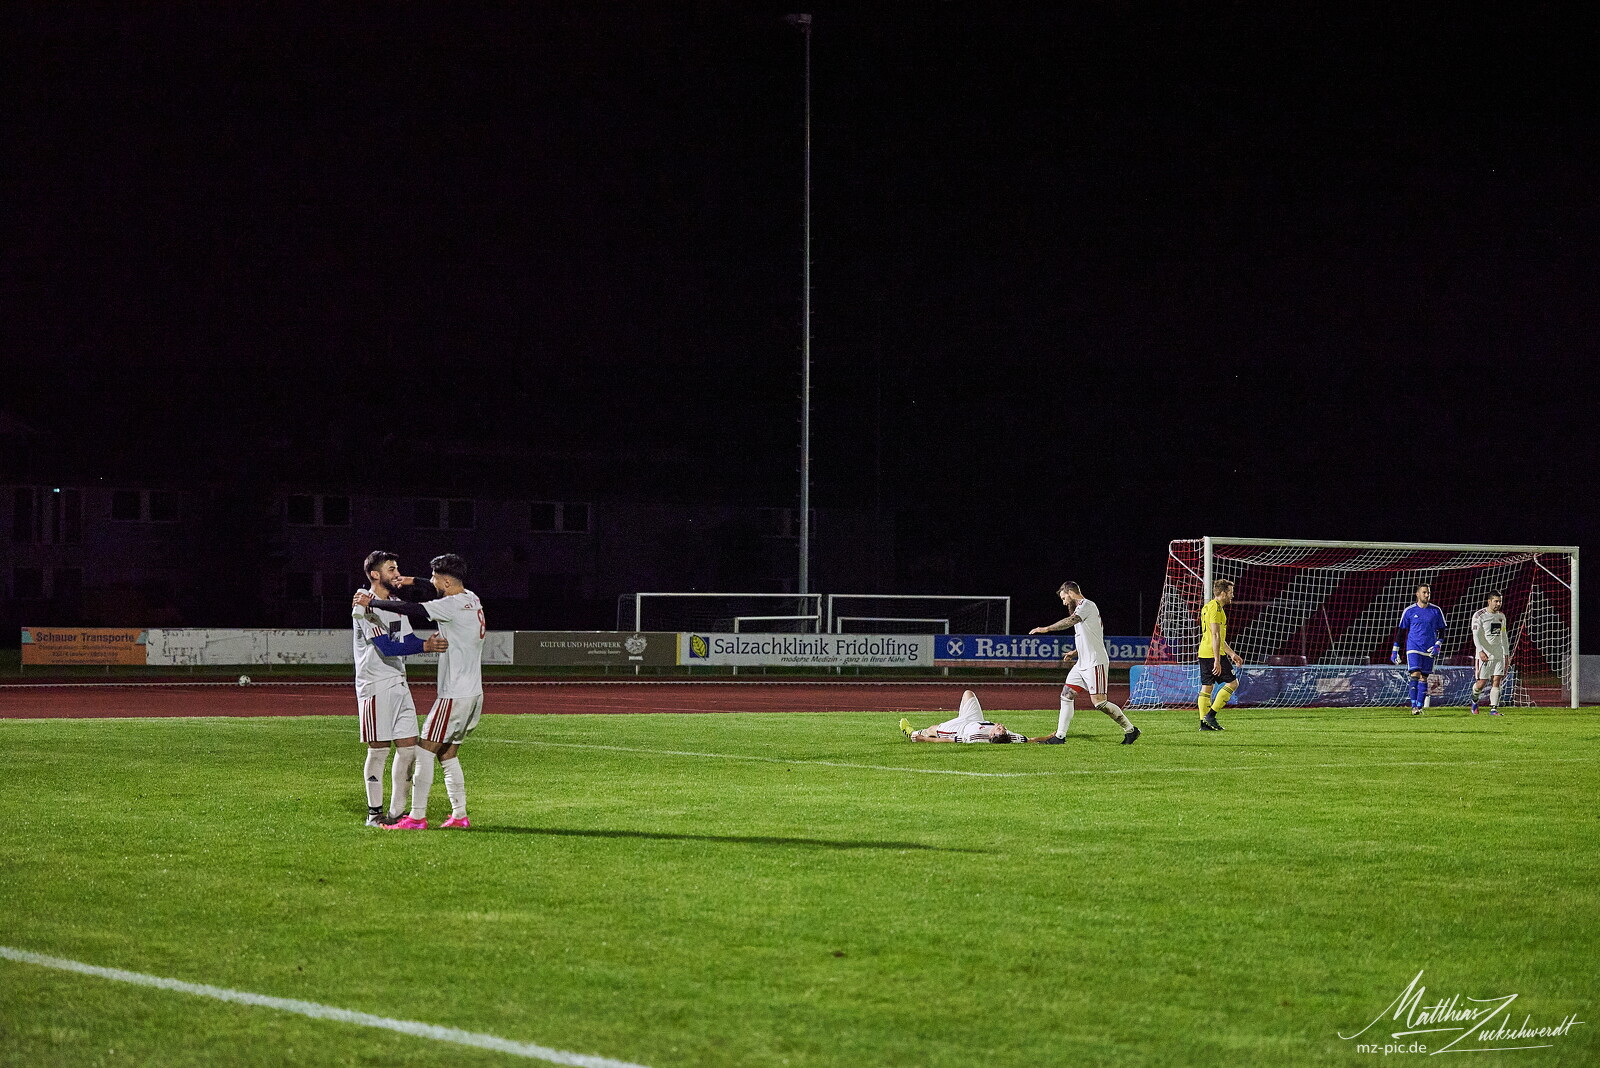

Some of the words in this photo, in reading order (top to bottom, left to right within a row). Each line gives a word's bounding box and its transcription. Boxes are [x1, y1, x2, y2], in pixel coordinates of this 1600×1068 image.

[477, 609, 485, 640] 8
[36, 632, 77, 642] Schauer
[81, 632, 134, 644] Transporte
[583, 641, 622, 649] HANDWERK
[714, 638, 830, 655] Salzachklinik
[836, 638, 919, 660] Fridolfing
[975, 638, 1168, 658] Raiffeisbank
[843, 657, 861, 665] ganz
